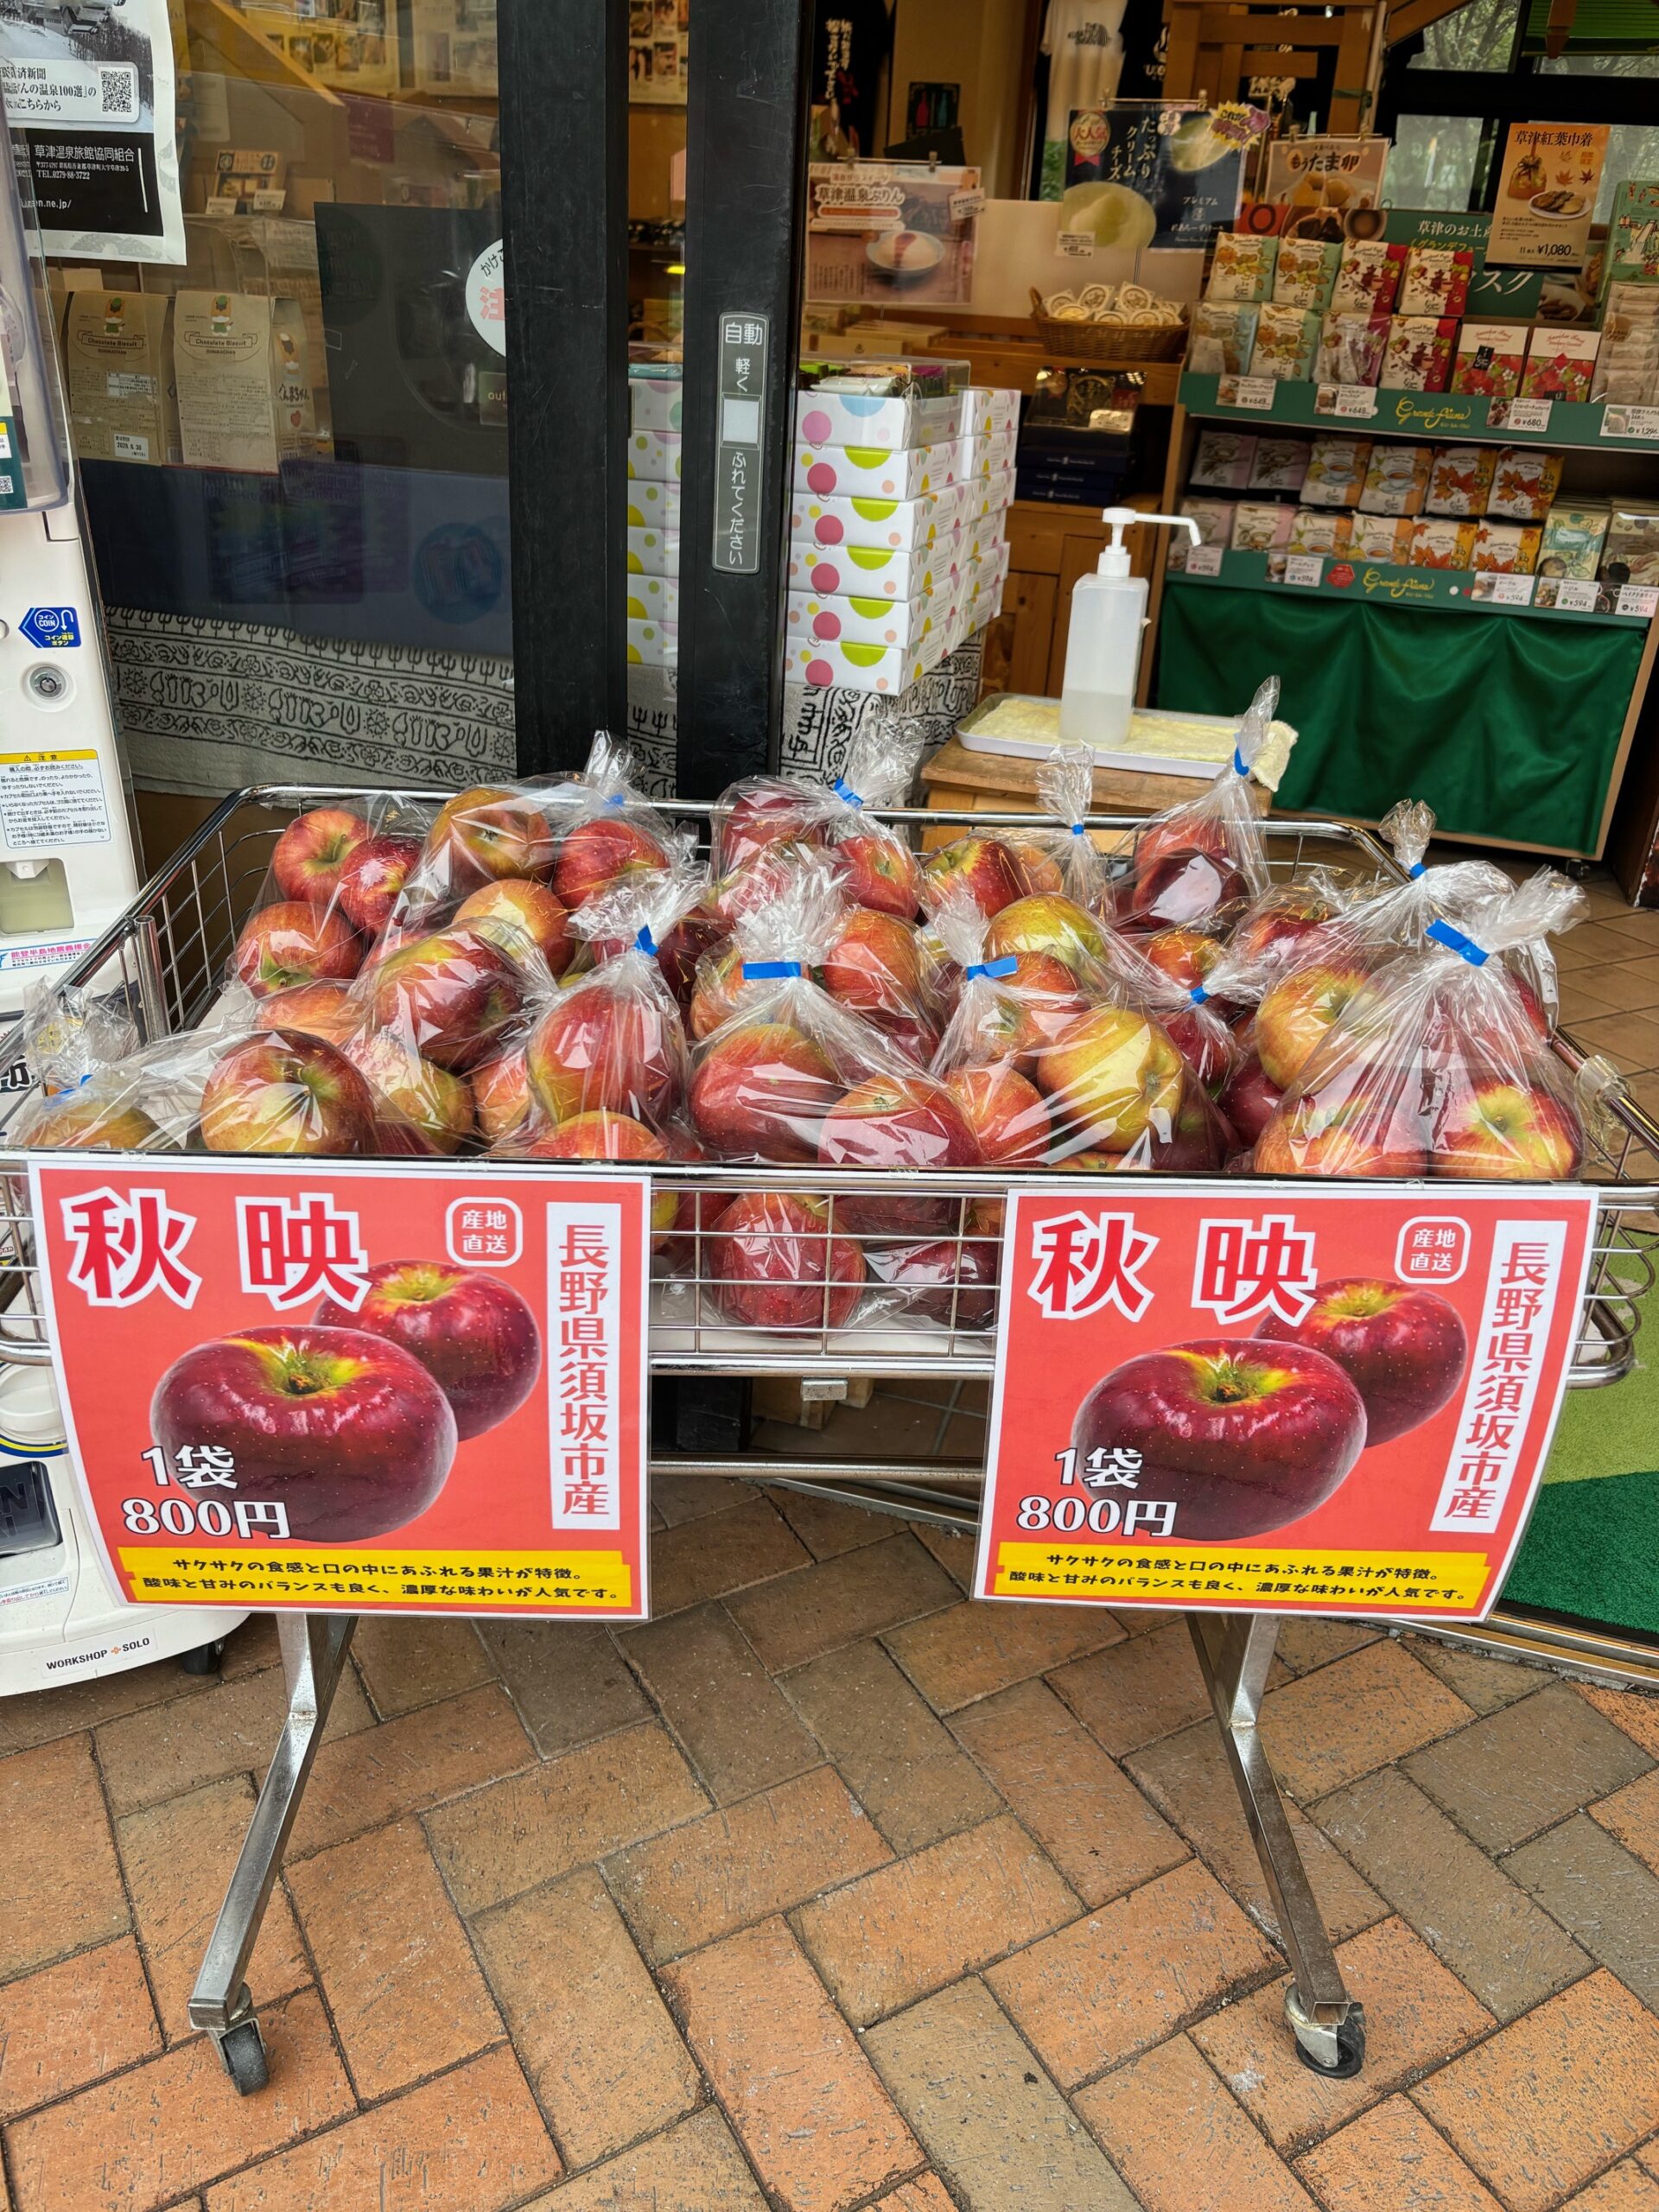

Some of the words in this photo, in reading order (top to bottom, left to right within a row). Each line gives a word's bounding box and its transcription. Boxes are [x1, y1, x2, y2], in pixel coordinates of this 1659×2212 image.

[1123, 126, 1138, 177] クリーム
[1137, 117, 1156, 179] たっぷり
[1516, 130, 1593, 147] 草津紅葉巾着
[35, 145, 135, 162] 草津温泉旅館協同組合
[1108, 145, 1123, 181] チーズ
[817, 185, 903, 204] 草津温泉ぷりん
[1182, 195, 1218, 207] プレミアム
[1537, 244, 1572, 256] ¥1,080
[725, 322, 763, 346] 自動
[735, 357, 751, 392] 軽く
[1522, 418, 1541, 427] ¥680
[729, 452, 747, 565] ふれてください
[11, 943, 91, 958] 能登半島地震義援金
[461, 1209, 508, 1231] 産地
[60, 1186, 372, 1313] 秋映
[461, 1234, 508, 1255] 直送
[1413, 1227, 1457, 1249] 産地
[1028, 1211, 1319, 1326] 秋映
[1410, 1250, 1453, 1273] 直送
[558, 1224, 610, 1517] 長野県須坂市産
[1444, 1240, 1551, 1520] 長野県須坂市産
[141, 1445, 238, 1490] 1袋
[1054, 1446, 1143, 1490] 1袋
[120, 1498, 291, 1540] 800円
[1016, 1497, 1178, 1538] 800円
[172, 1559, 582, 1580] サクサクの食感と口の中にあふれる果汁が特徴。
[1046, 1554, 1440, 1580] サクサクの食感と口の中にあふれる果汁が特徴。
[143, 1577, 618, 1599] 酸味と甘みのバランスも良く、濃厚な味わいが人気です。
[1008, 1570, 1466, 1600] 酸味と甘みのバランスも良く、濃厚な味わいが人気です。
[46, 1649, 108, 1669] WORKSHOP
[123, 1637, 150, 1652] SOLO
